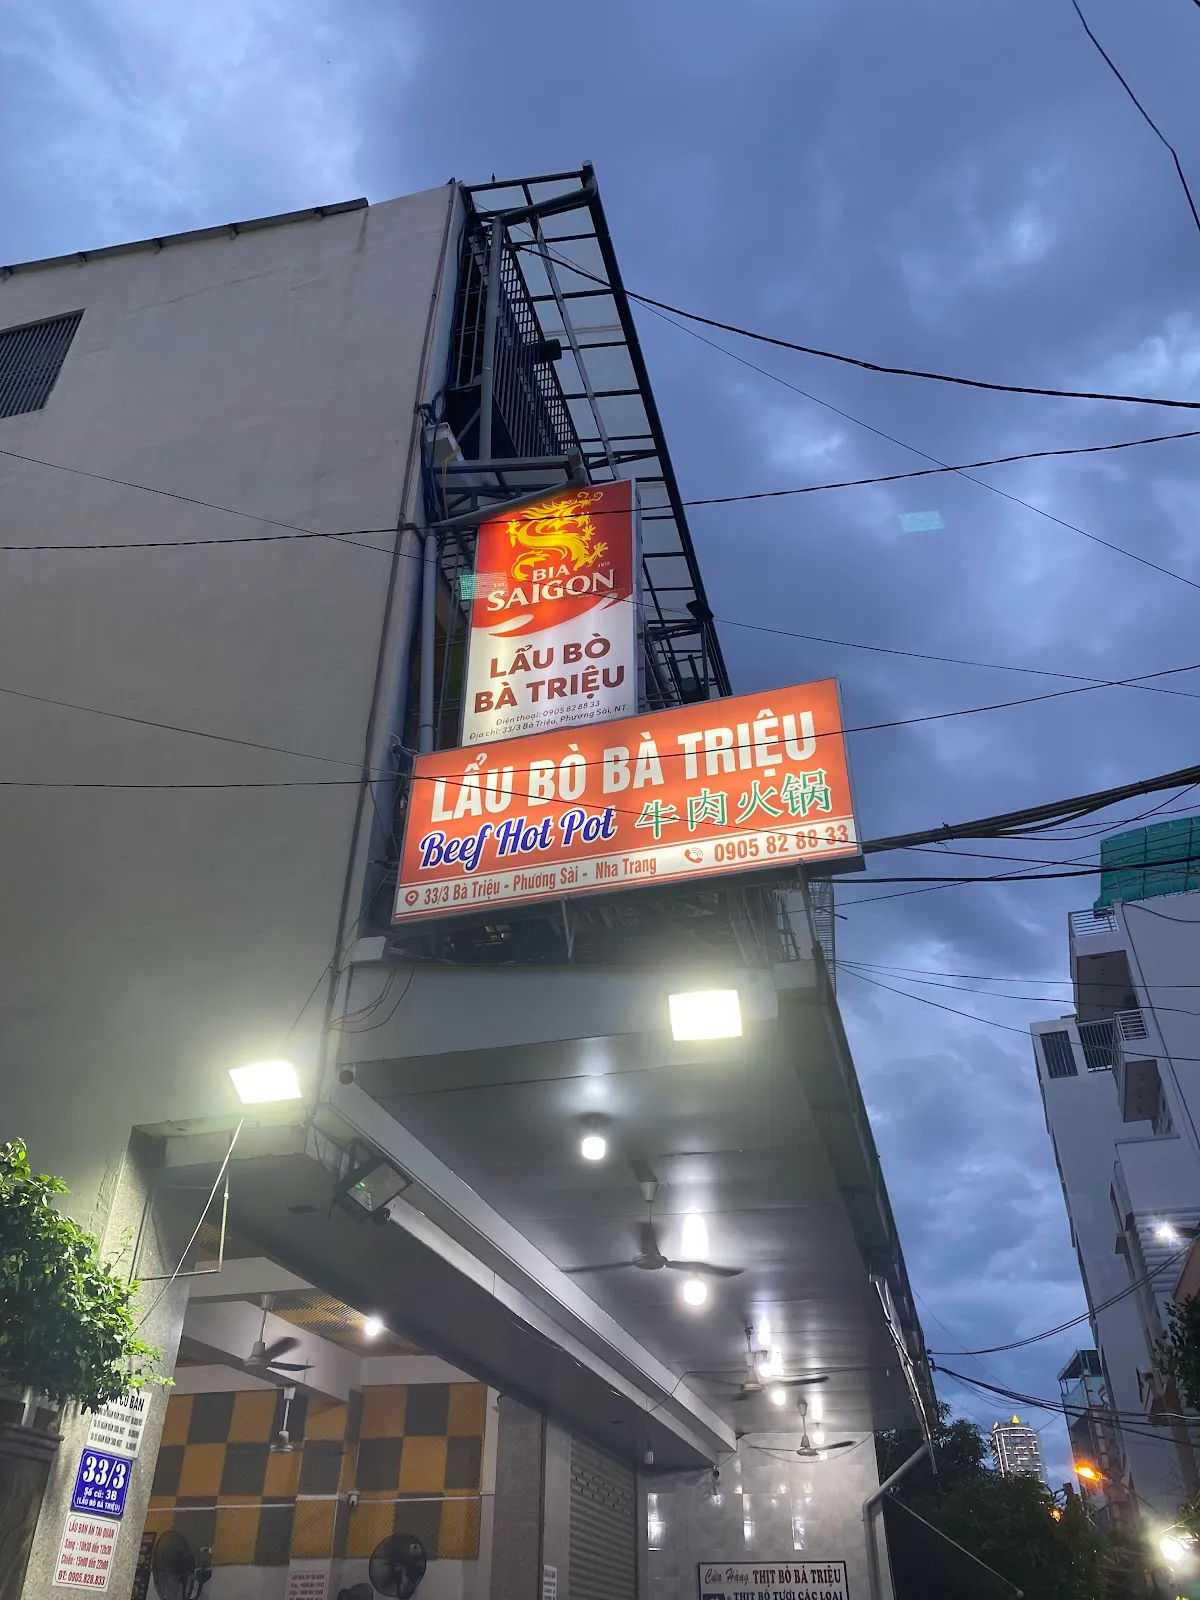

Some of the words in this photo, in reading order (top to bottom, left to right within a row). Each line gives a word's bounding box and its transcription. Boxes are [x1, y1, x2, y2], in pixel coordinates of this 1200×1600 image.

[487, 569, 615, 612] SAIGON
[532, 564, 571, 582] BIA
[489, 644, 554, 679] LẨU
[562, 633, 611, 665] BÒ
[474, 681, 518, 714] BÀ
[526, 665, 625, 703] TRIỆU
[542, 706, 565, 717] 0905
[565, 704, 577, 713] 82
[577, 702, 588, 711] 88
[589, 700, 601, 709] 33
[502, 722, 521, 735] 33/3
[560, 710, 595, 724] Phương
[614, 704, 627, 712] NT
[431, 752, 514, 823] LẨU
[528, 743, 587, 807] BÒ
[602, 731, 664, 795] BÀ
[677, 708, 817, 780] TRIỆU
[634, 767, 833, 841] 牛肉火锅
[419, 823, 493, 873] Beef
[495, 815, 555, 858] Hot
[560, 805, 619, 849] Pot
[714, 837, 759, 863] 0905
[766, 834, 789, 854] 82
[795, 829, 818, 850] 88
[824, 824, 848, 846] 33
[423, 885, 450, 906] 33/3
[453, 882, 468, 901] Bà
[472, 878, 500, 900] Triệu
[513, 872, 556, 893] Phương
[560, 865, 578, 885] Sài
[595, 860, 618, 880] Nha
[622, 857, 657, 876] Trang
[82, 1456, 126, 1489] 33/3
[105, 1489, 118, 1500] 3B
[725, 1567, 749, 1587] Hàng
[753, 1569, 776, 1588] THỊT
[778, 1565, 791, 1583] BÒ
[794, 1565, 808, 1583] BÀ
[811, 1564, 841, 1587] TRIỆU
